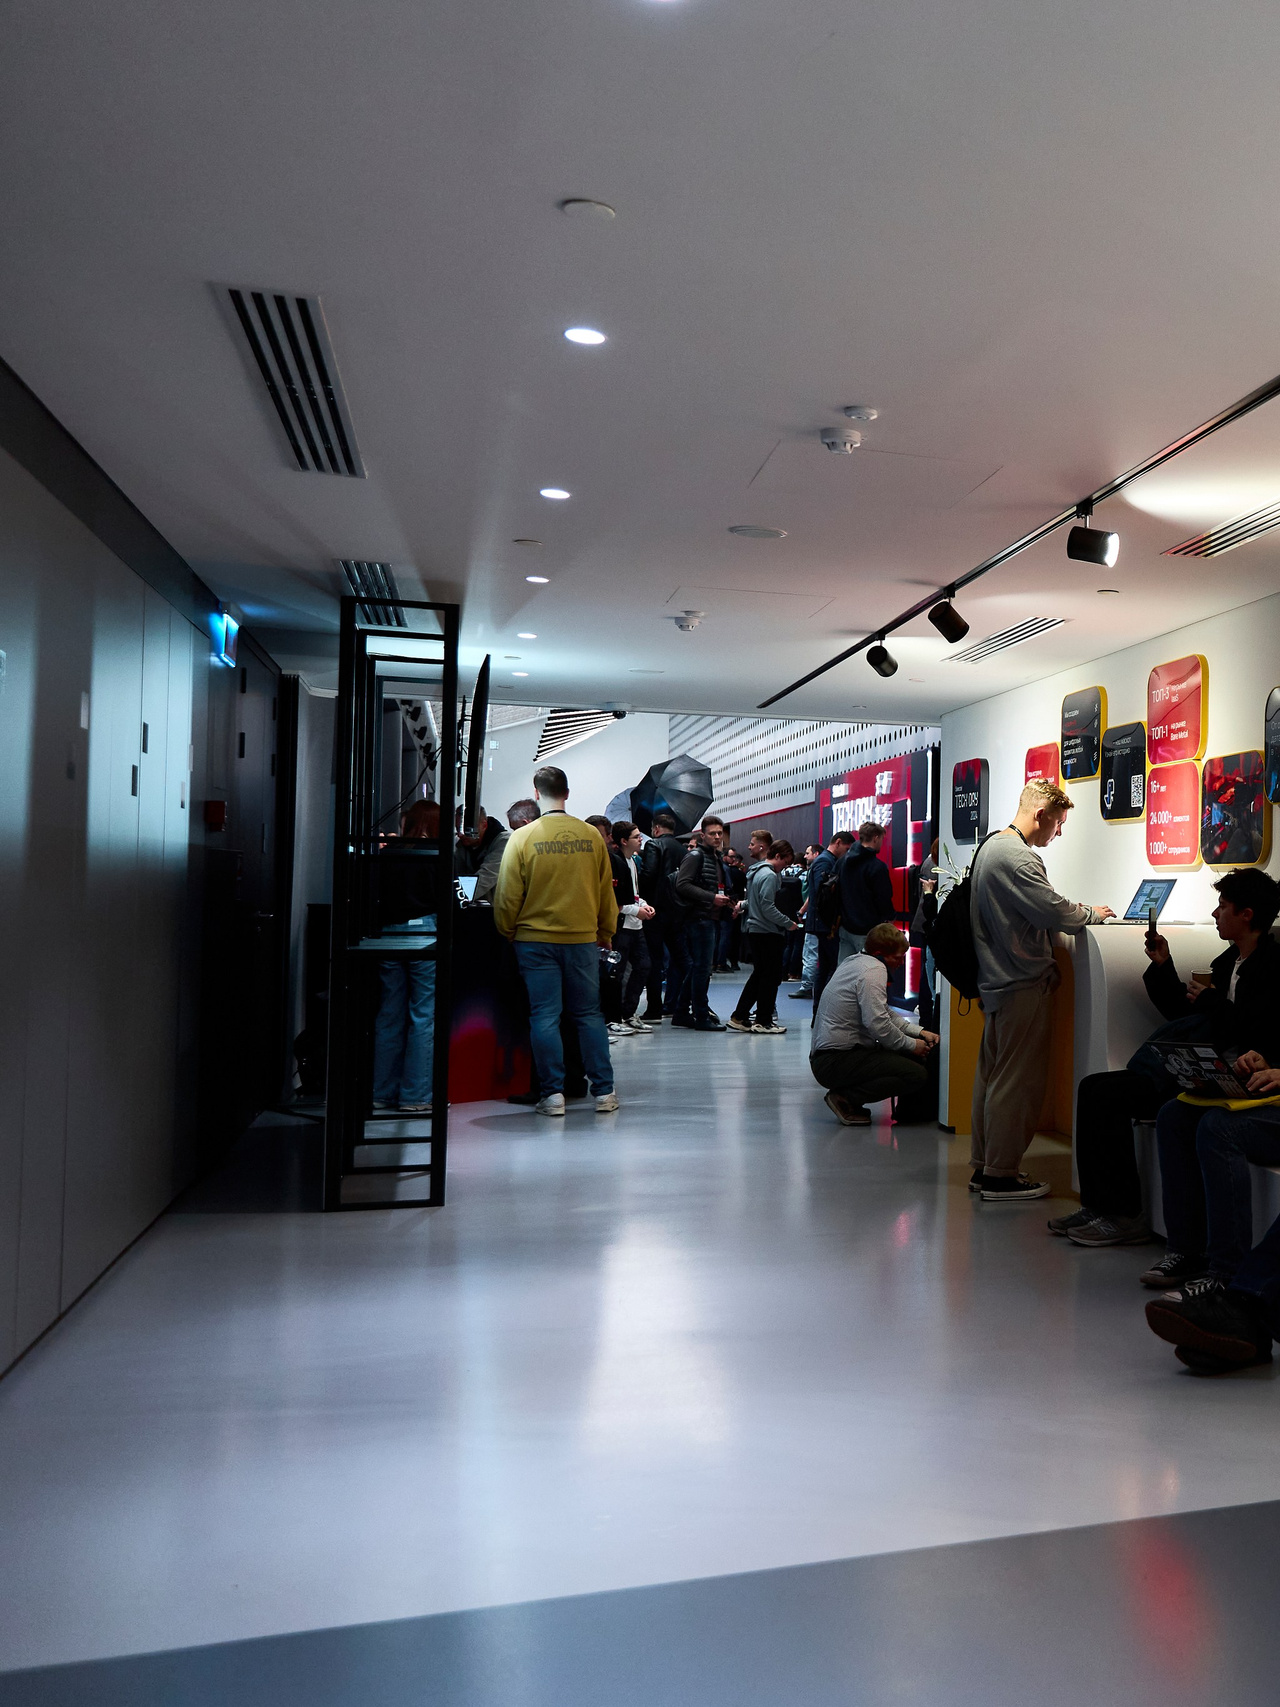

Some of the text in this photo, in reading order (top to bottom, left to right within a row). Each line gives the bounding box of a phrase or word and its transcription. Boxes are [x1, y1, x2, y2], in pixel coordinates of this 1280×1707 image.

[1152, 687, 1170, 703] ТОП-3
[1151, 725, 1168, 740] ТОП-1
[1151, 780, 1160, 793] 16+
[955, 793, 968, 808] TECH
[832, 800, 855, 835] TECH
[534, 839, 594, 855] WOODSTOCK
